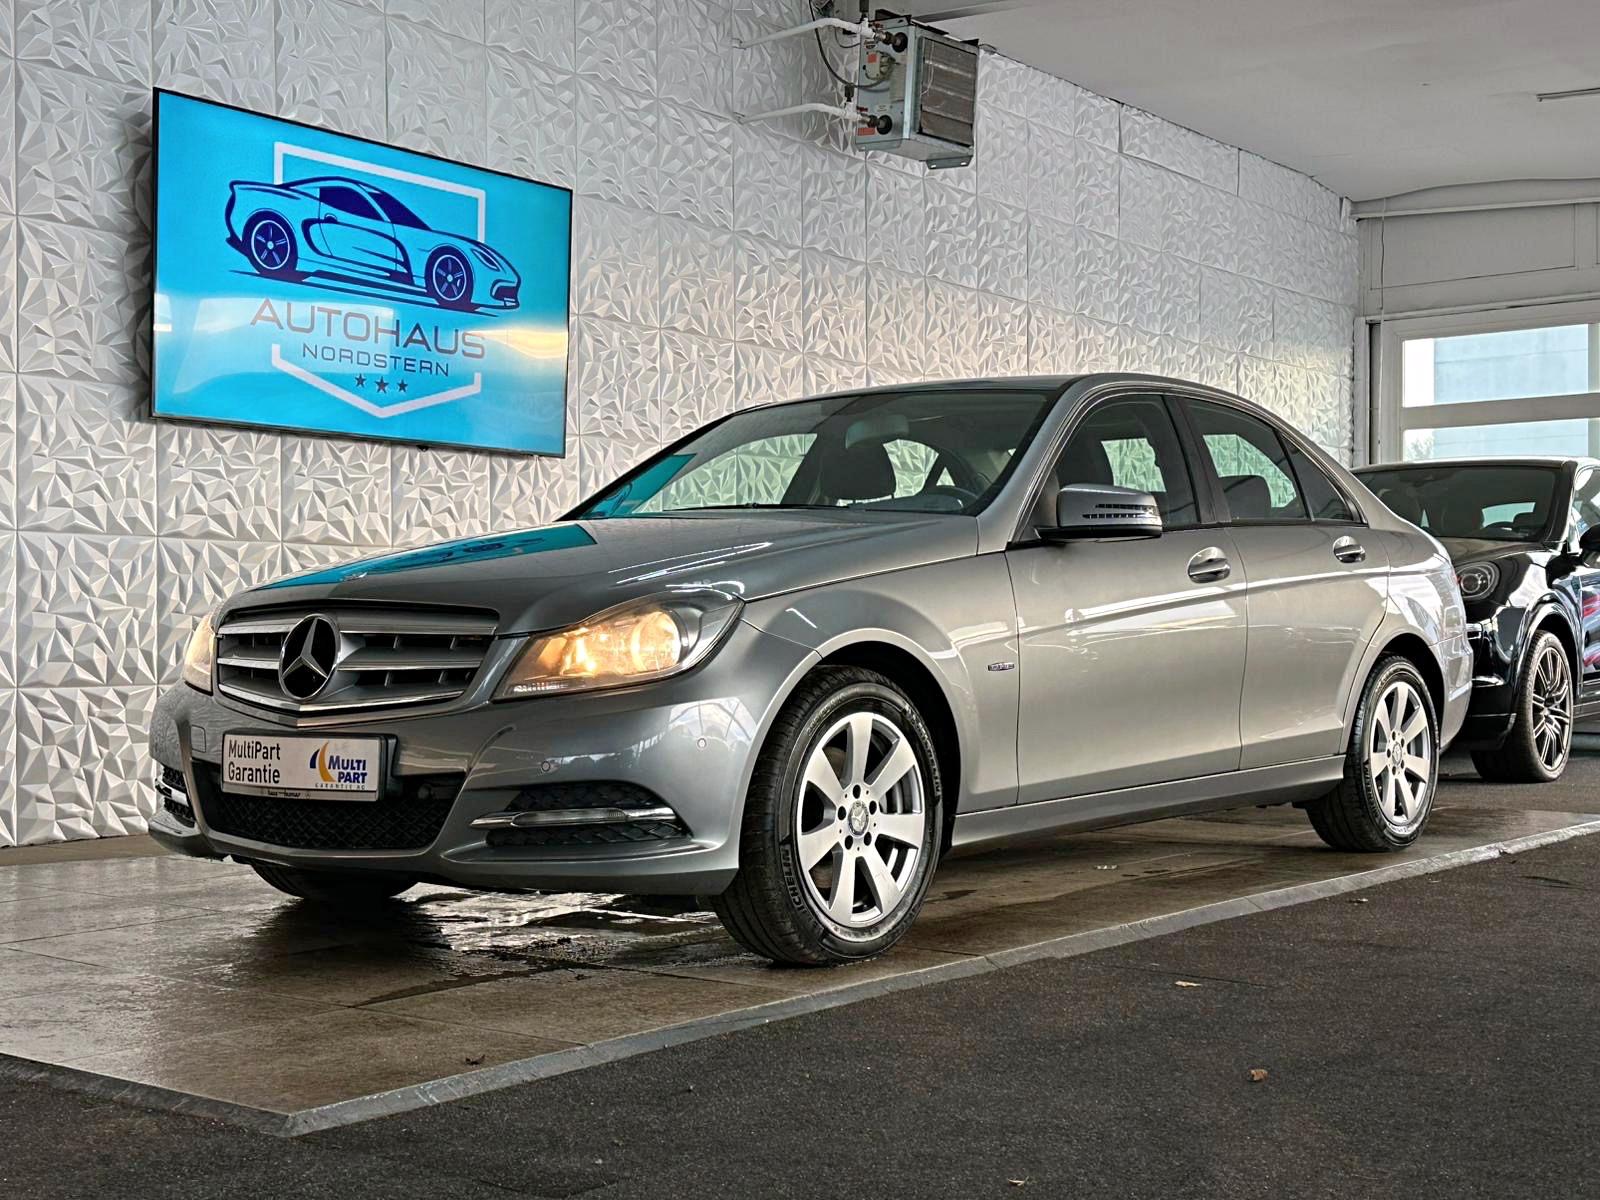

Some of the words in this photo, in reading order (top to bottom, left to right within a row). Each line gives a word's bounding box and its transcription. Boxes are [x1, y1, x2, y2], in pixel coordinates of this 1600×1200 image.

[250, 297, 486, 360] AUTOHAUS
[302, 342, 449, 377] NORDSTERN
[228, 739, 281, 761] MultiPart
[228, 762, 281, 784] Garantie
[328, 755, 366, 771] MULTI
[337, 771, 368, 784] PART
